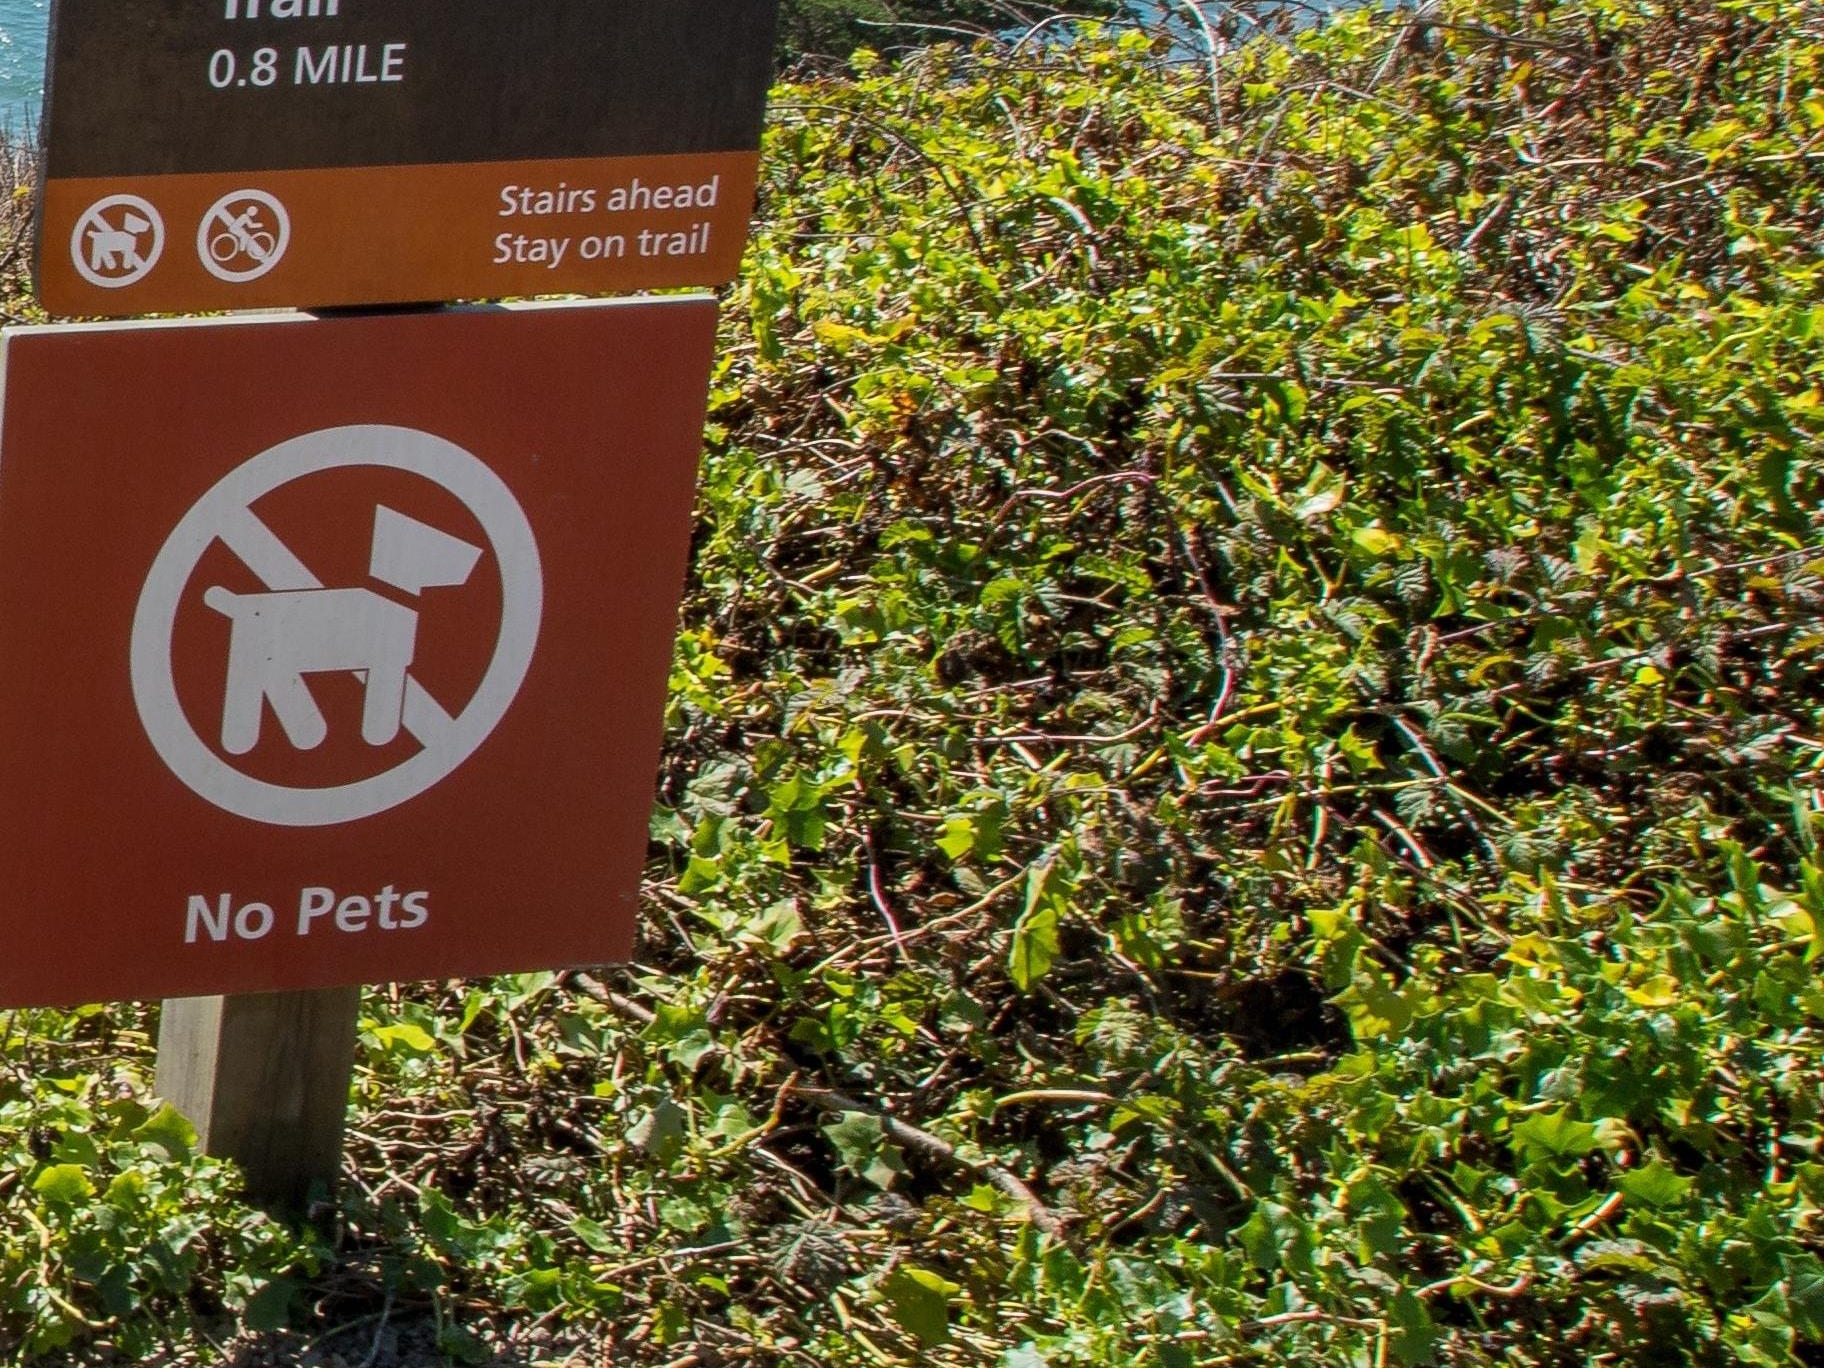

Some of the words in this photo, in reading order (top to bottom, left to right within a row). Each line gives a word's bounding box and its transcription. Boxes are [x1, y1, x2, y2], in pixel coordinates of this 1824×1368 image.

[209, 47, 278, 88] 0.8
[294, 43, 406, 85] MILE
[499, 185, 597, 217] Stairs
[607, 175, 719, 211] ahead
[493, 232, 571, 269] Stay
[579, 235, 625, 259] on
[637, 222, 710, 257] trail
[184, 893, 274, 943] No
[297, 884, 429, 936] Pets
